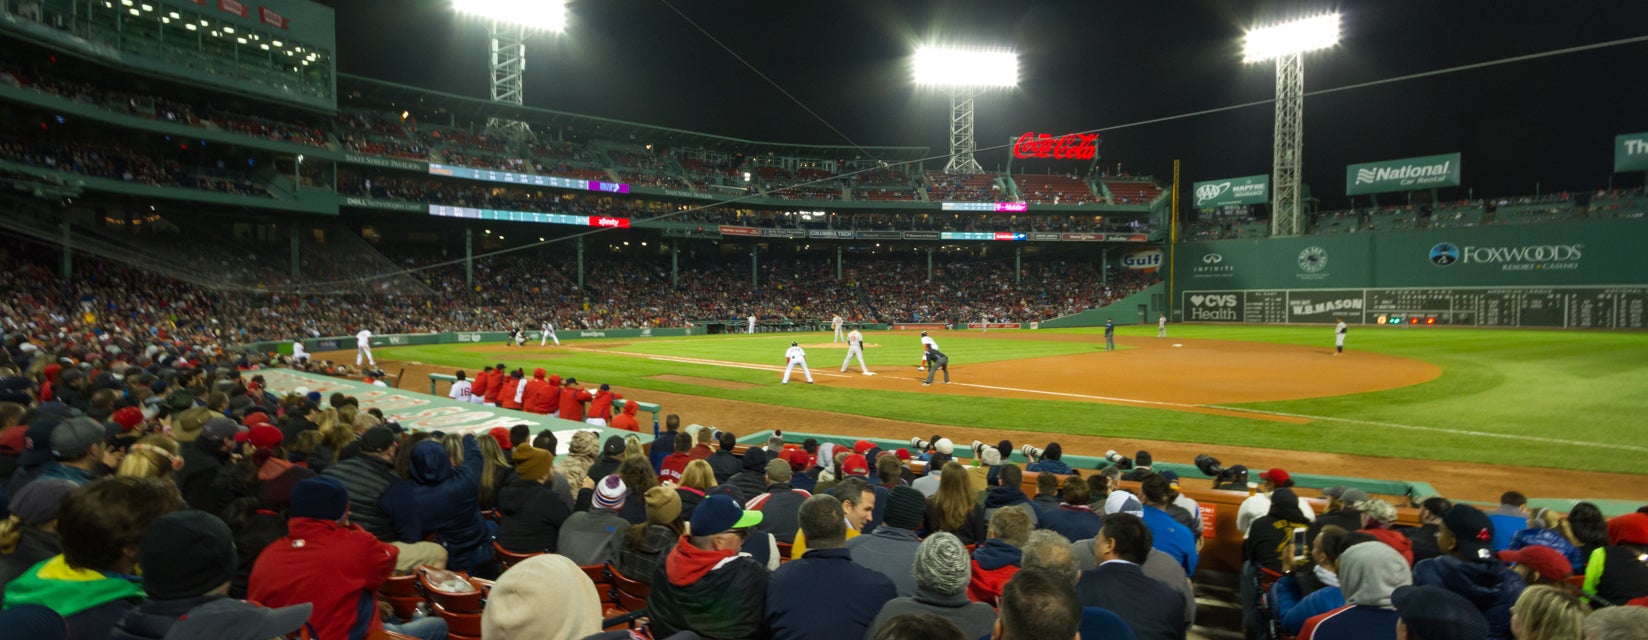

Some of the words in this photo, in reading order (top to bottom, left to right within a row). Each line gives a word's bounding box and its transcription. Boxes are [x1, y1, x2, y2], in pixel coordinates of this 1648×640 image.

[1013, 131, 1097, 160] Coca-Cola
[1376, 160, 1450, 181] National
[1400, 178, 1414, 186] Car
[1417, 175, 1446, 185] Rental
[598, 217, 619, 227] xfinity
[1463, 243, 1582, 264] FOXWOODS
[1123, 254, 1161, 266] Gulf
[1502, 263, 1534, 271] RESORT
[1542, 262, 1579, 270] CASINO
[1205, 294, 1237, 307] CVS
[1191, 307, 1237, 320] Health
[460, 387, 471, 397] 16
